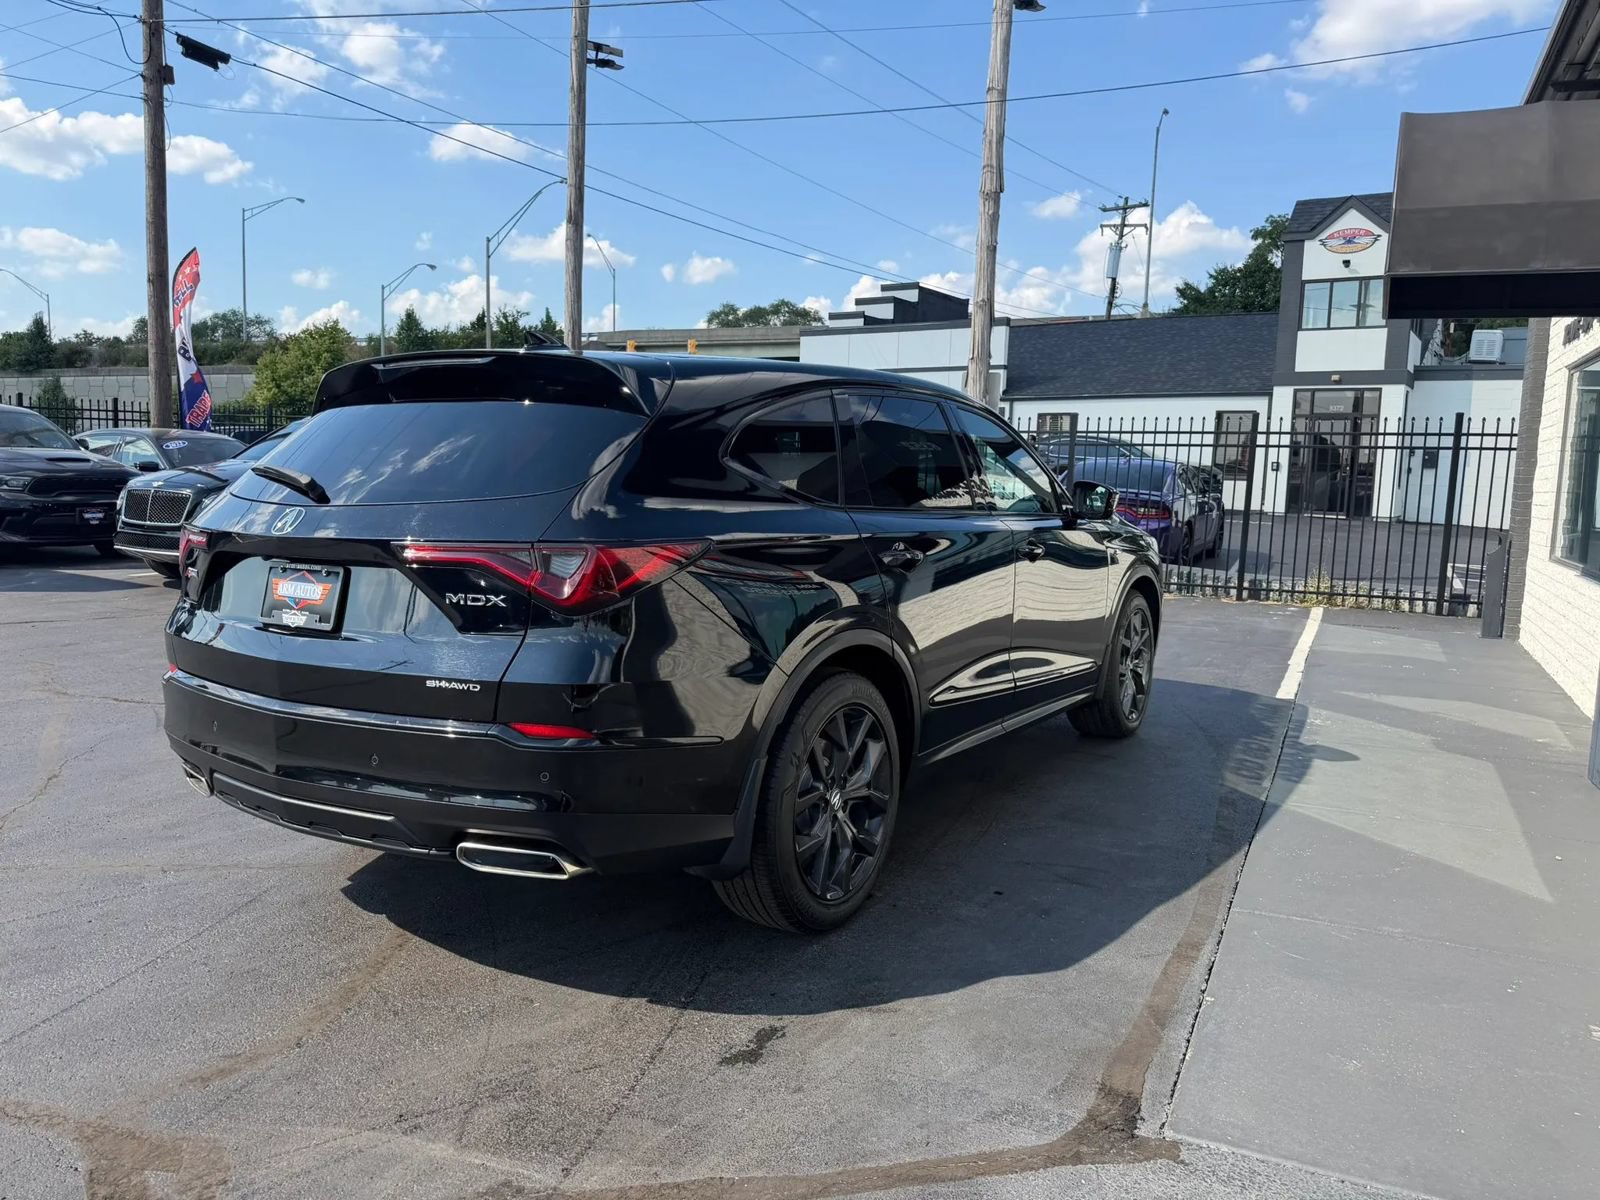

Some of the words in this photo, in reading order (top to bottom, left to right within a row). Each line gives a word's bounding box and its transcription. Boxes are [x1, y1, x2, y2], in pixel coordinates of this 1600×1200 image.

[1333, 229, 1366, 238] KEMPER
[186, 390, 211, 427] TRADE
[279, 582, 295, 595] ARM
[295, 584, 322, 599] AUTOS
[445, 592, 507, 608] MDX
